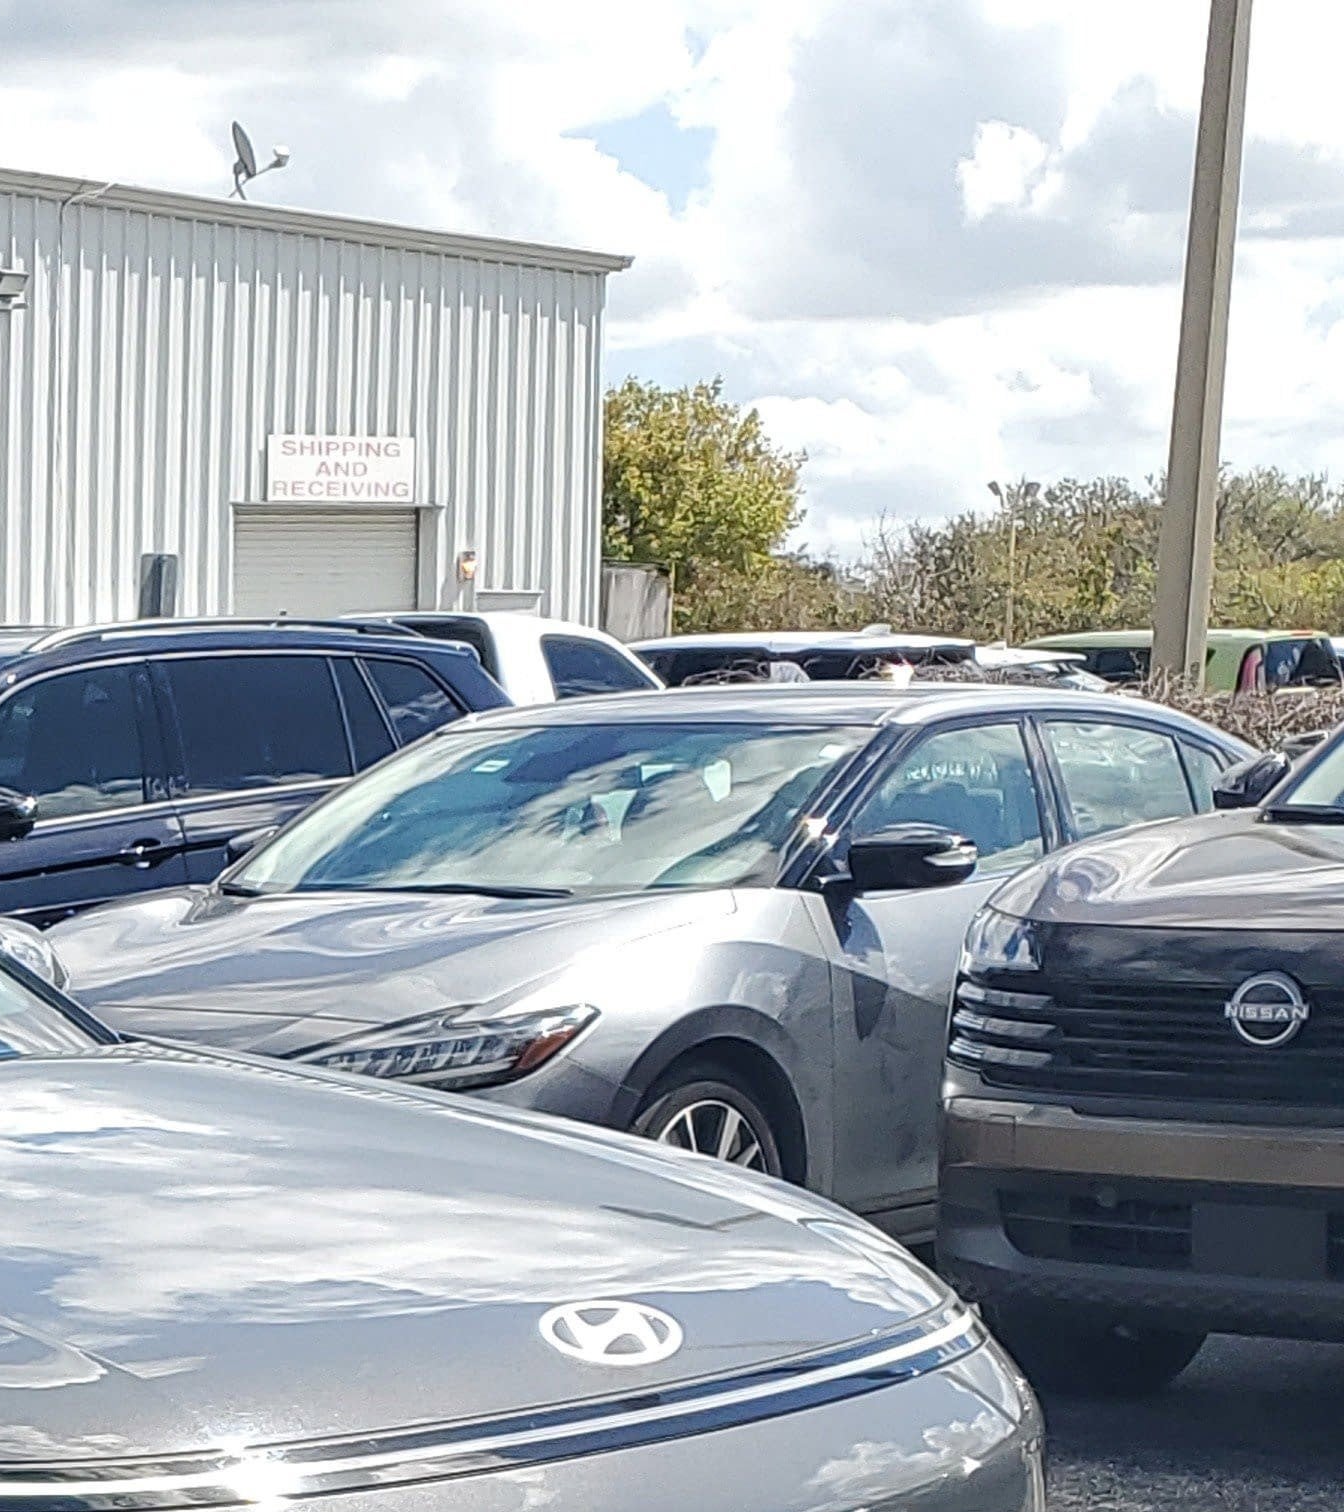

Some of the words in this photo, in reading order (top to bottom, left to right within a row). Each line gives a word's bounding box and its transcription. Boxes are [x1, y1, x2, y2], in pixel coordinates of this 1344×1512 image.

[281, 439, 400, 458] SHIPPING
[316, 461, 368, 477] AND
[272, 480, 409, 497] RECEIVING
[1224, 1002, 1310, 1020] NISSAN
